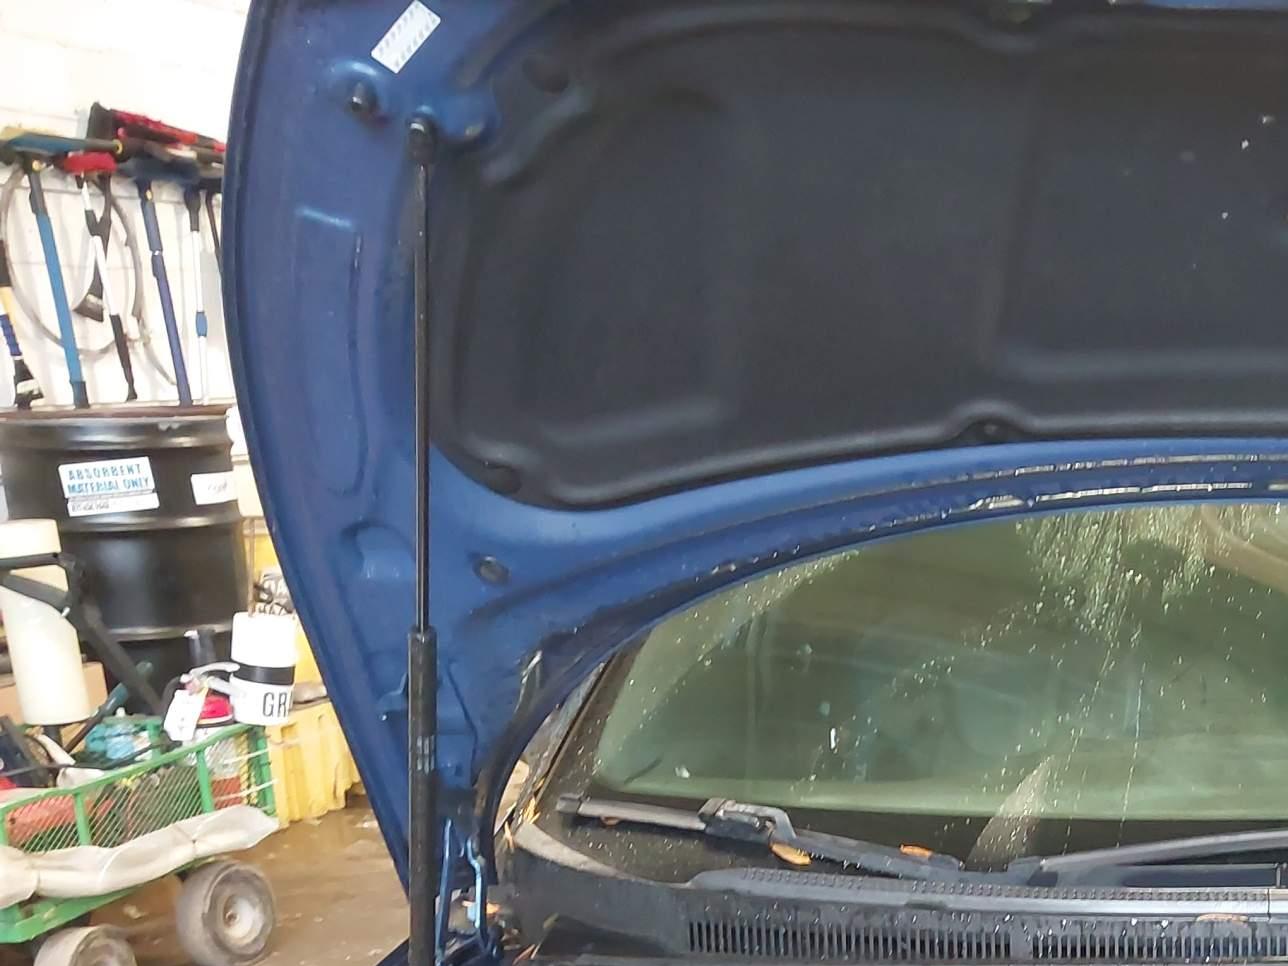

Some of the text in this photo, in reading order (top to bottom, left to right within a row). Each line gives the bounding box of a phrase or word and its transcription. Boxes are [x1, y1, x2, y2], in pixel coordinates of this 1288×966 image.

[68, 463, 141, 480] ABSORBENT
[67, 477, 149, 494] MATERIAL ONLY
[262, 692, 293, 718] GR
